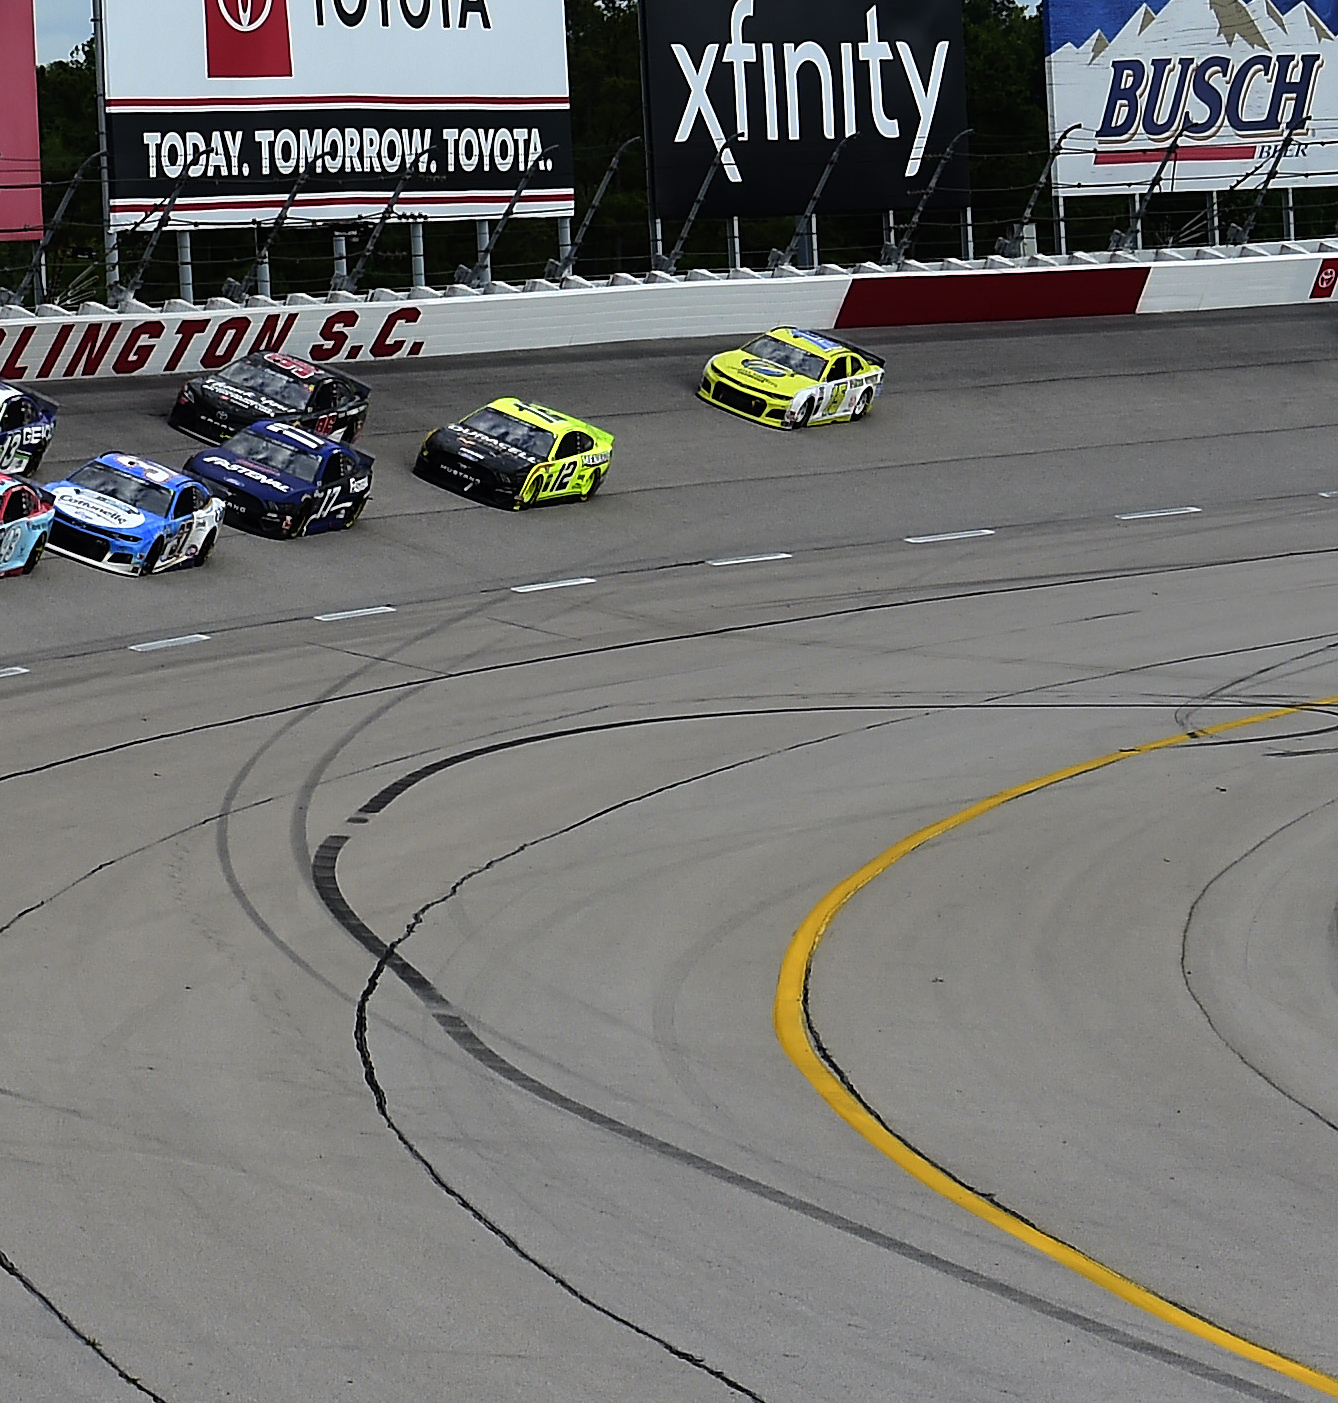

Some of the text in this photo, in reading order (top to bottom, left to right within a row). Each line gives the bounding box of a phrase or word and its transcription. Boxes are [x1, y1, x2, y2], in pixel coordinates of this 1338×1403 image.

[1095, 54, 1321, 142] BUSCH
[144, 128, 552, 178] TODAY. TOMORROW. TOYOTA.
[309, 307, 425, 362] S.C.
[204, 457, 291, 493] FASTENAL
[550, 461, 578, 492] 12
[317, 486, 342, 519] 17
